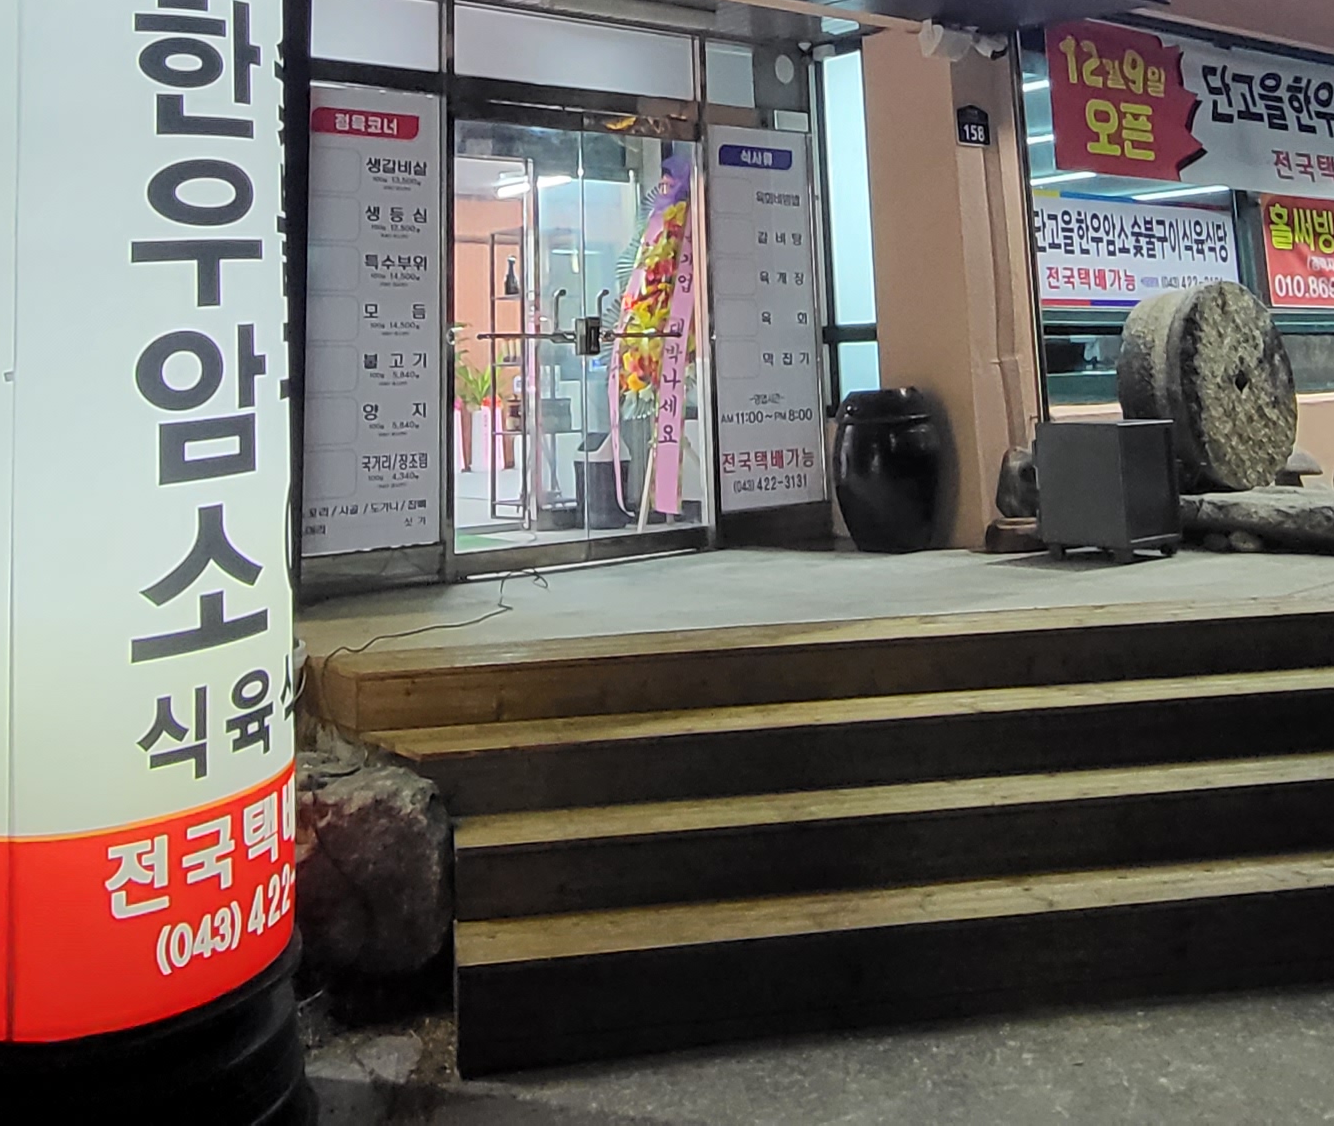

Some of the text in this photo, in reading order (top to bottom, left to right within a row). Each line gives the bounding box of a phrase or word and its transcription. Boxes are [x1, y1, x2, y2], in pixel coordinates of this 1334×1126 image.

[963, 124, 985, 142] 158
[1085, 98, 1156, 161] 오픈
[1046, 266, 1136, 292] 전국택배가능
[722, 448, 814, 474] 전국택배가능
